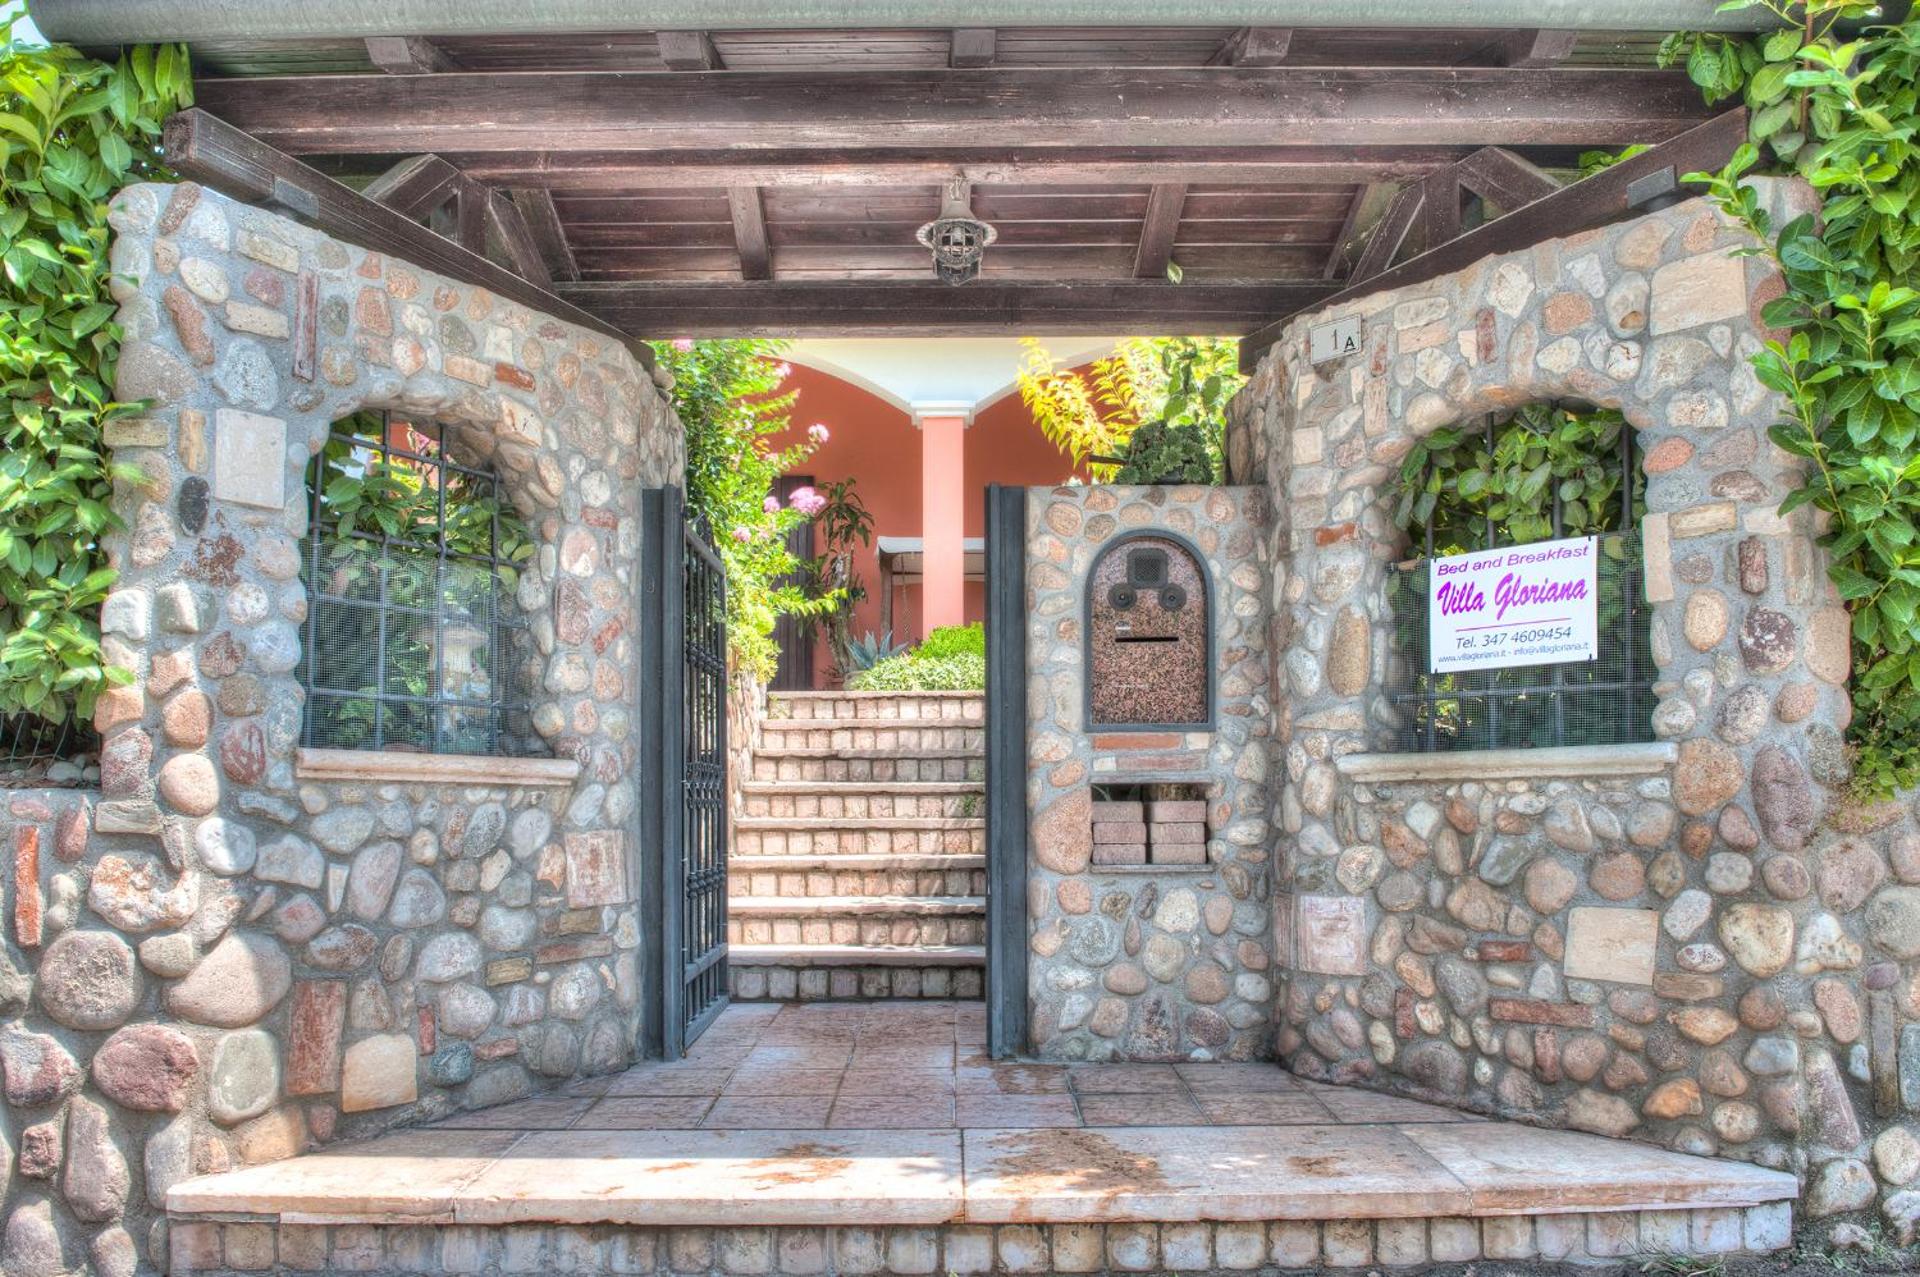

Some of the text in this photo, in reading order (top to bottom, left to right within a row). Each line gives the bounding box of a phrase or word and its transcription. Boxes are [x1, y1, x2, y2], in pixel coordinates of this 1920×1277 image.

[1437, 545, 1589, 576] Bed and Breakfast
[1437, 572, 1588, 621] Villa Gloriana
[1456, 626, 1572, 649] Tel. 347 4609454
[1438, 649, 1507, 663] www.villagloriana.it
[1513, 642, 1589, 656] info@villagloriana.it
